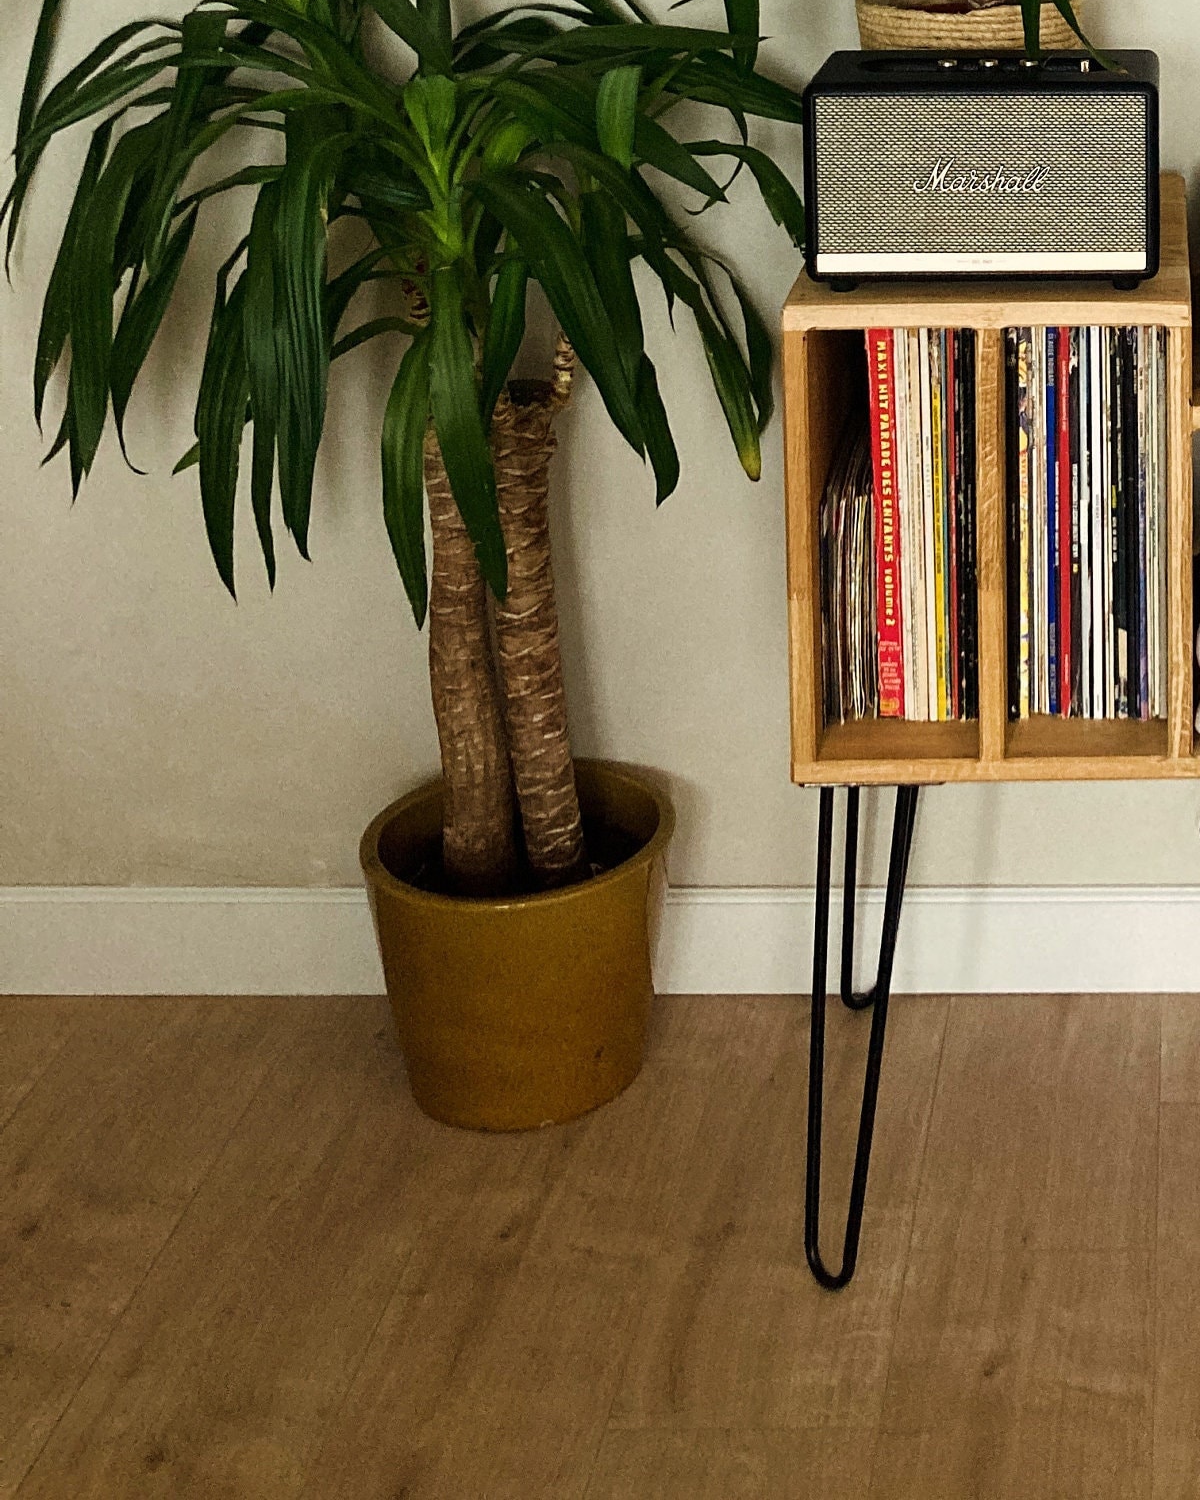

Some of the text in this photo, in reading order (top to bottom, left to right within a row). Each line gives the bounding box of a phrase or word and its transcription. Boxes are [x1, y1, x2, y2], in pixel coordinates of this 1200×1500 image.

[913, 157, 1051, 194] Marshall
[875, 340, 888, 380] MAXI
[877, 384, 890, 410] HIT
[877, 413, 892, 467] PARADE
[880, 470, 893, 497] DES
[881, 499, 895, 563] ENFANTS
[883, 568, 895, 615] volume
[884, 618, 896, 626] 2
